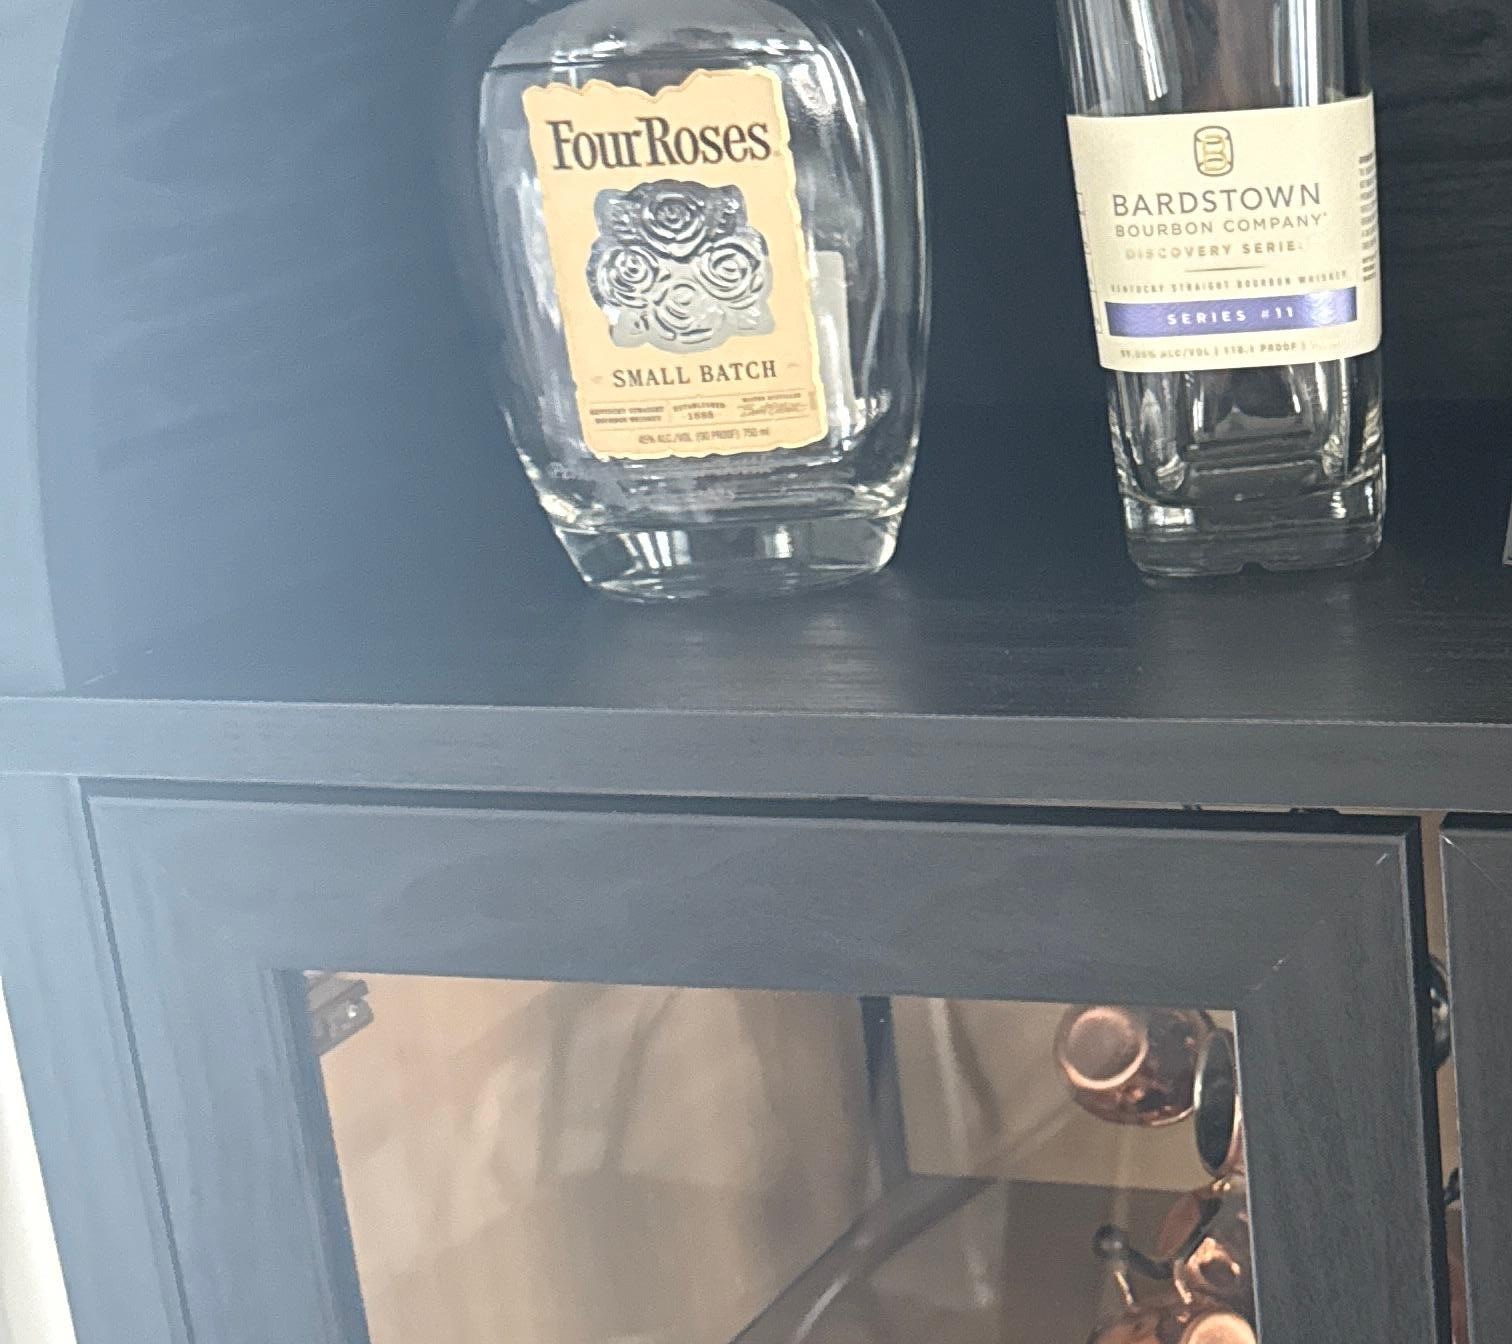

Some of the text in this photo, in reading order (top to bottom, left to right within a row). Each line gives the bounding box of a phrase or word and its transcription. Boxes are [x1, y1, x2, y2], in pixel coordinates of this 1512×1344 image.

[1112, 182, 1321, 217] BARDSTOWN
[1115, 213, 1323, 238] BOURBON COMPANY
[1125, 244, 1231, 261] DISCOVERY
[1167, 306, 1294, 326] SERIES #11
[612, 359, 777, 389] SMALL BATCH
